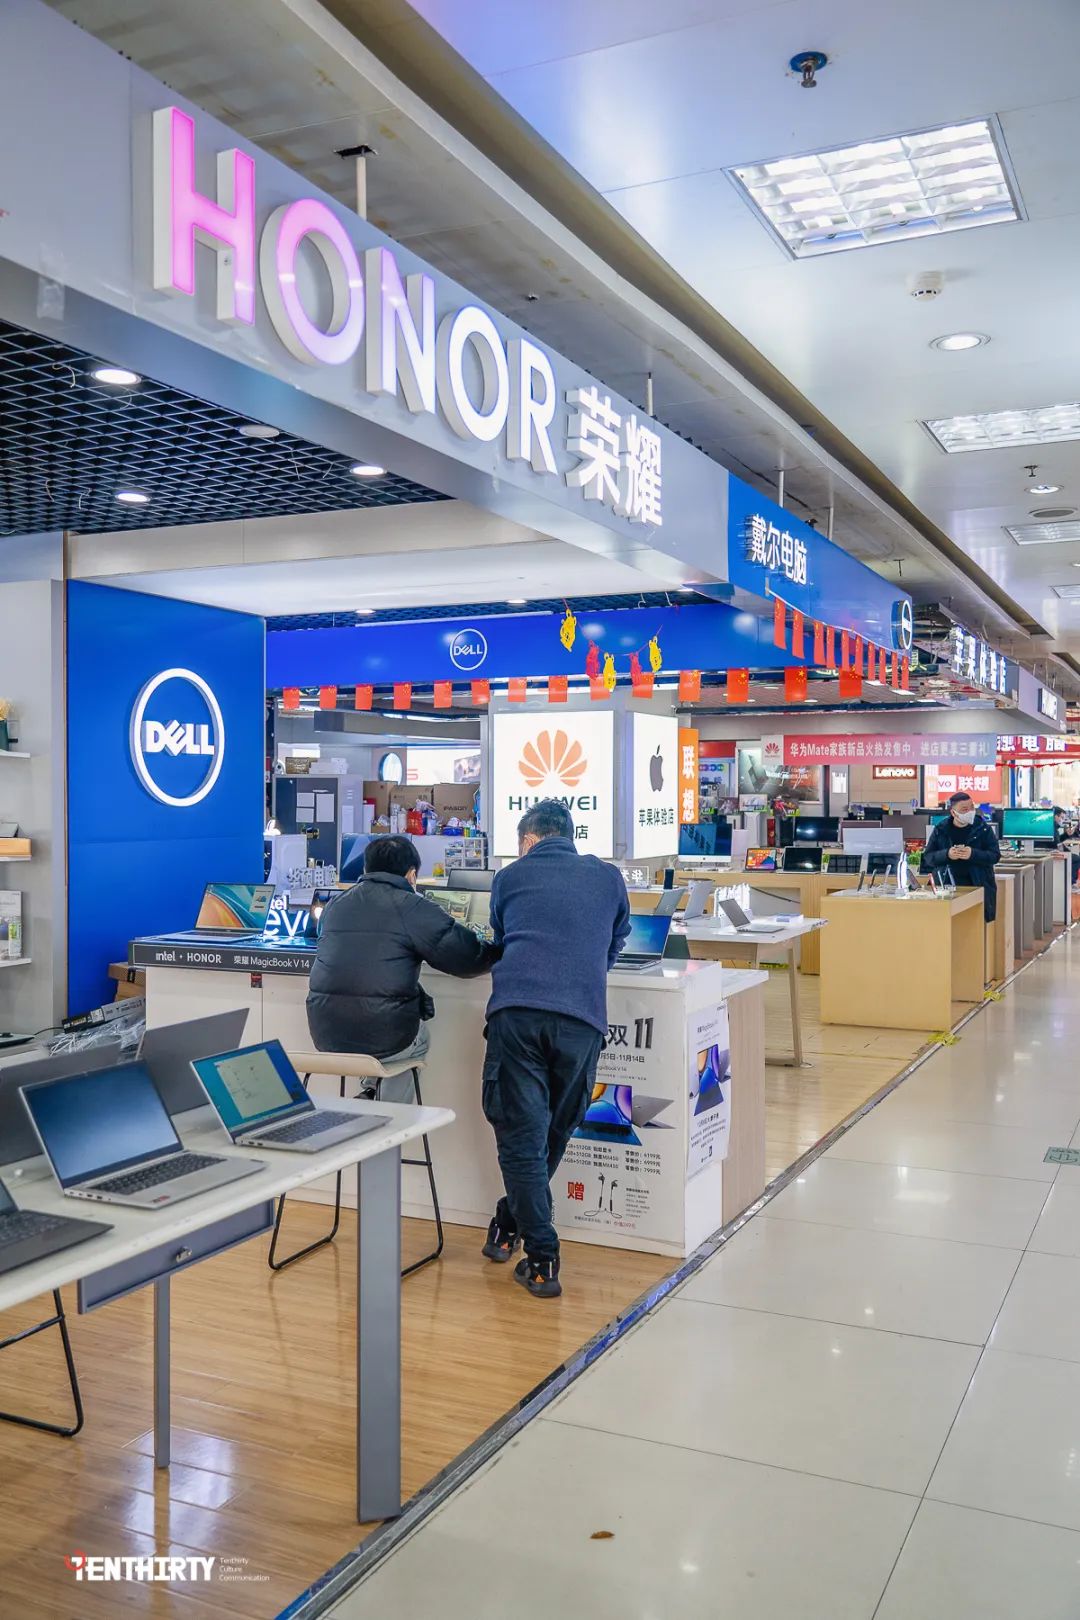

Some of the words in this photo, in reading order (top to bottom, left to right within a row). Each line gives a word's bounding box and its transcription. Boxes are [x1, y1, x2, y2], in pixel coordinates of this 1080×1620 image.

[153, 105, 558, 475] HONOR
[566, 386, 663, 527] 荣耀
[749, 513, 807, 585] 戴尔电脑
[453, 644, 484, 657] DELL
[142, 719, 215, 756] DELL
[875, 766, 916, 778] Lenovo
[508, 796, 598, 811] HUWEI
[155, 950, 176, 961] intel
[187, 953, 222, 964] HONOR
[250, 955, 293, 968] MagicBook
[300, 959, 310, 968] 14
[567, 1181, 585, 1201] 赠
